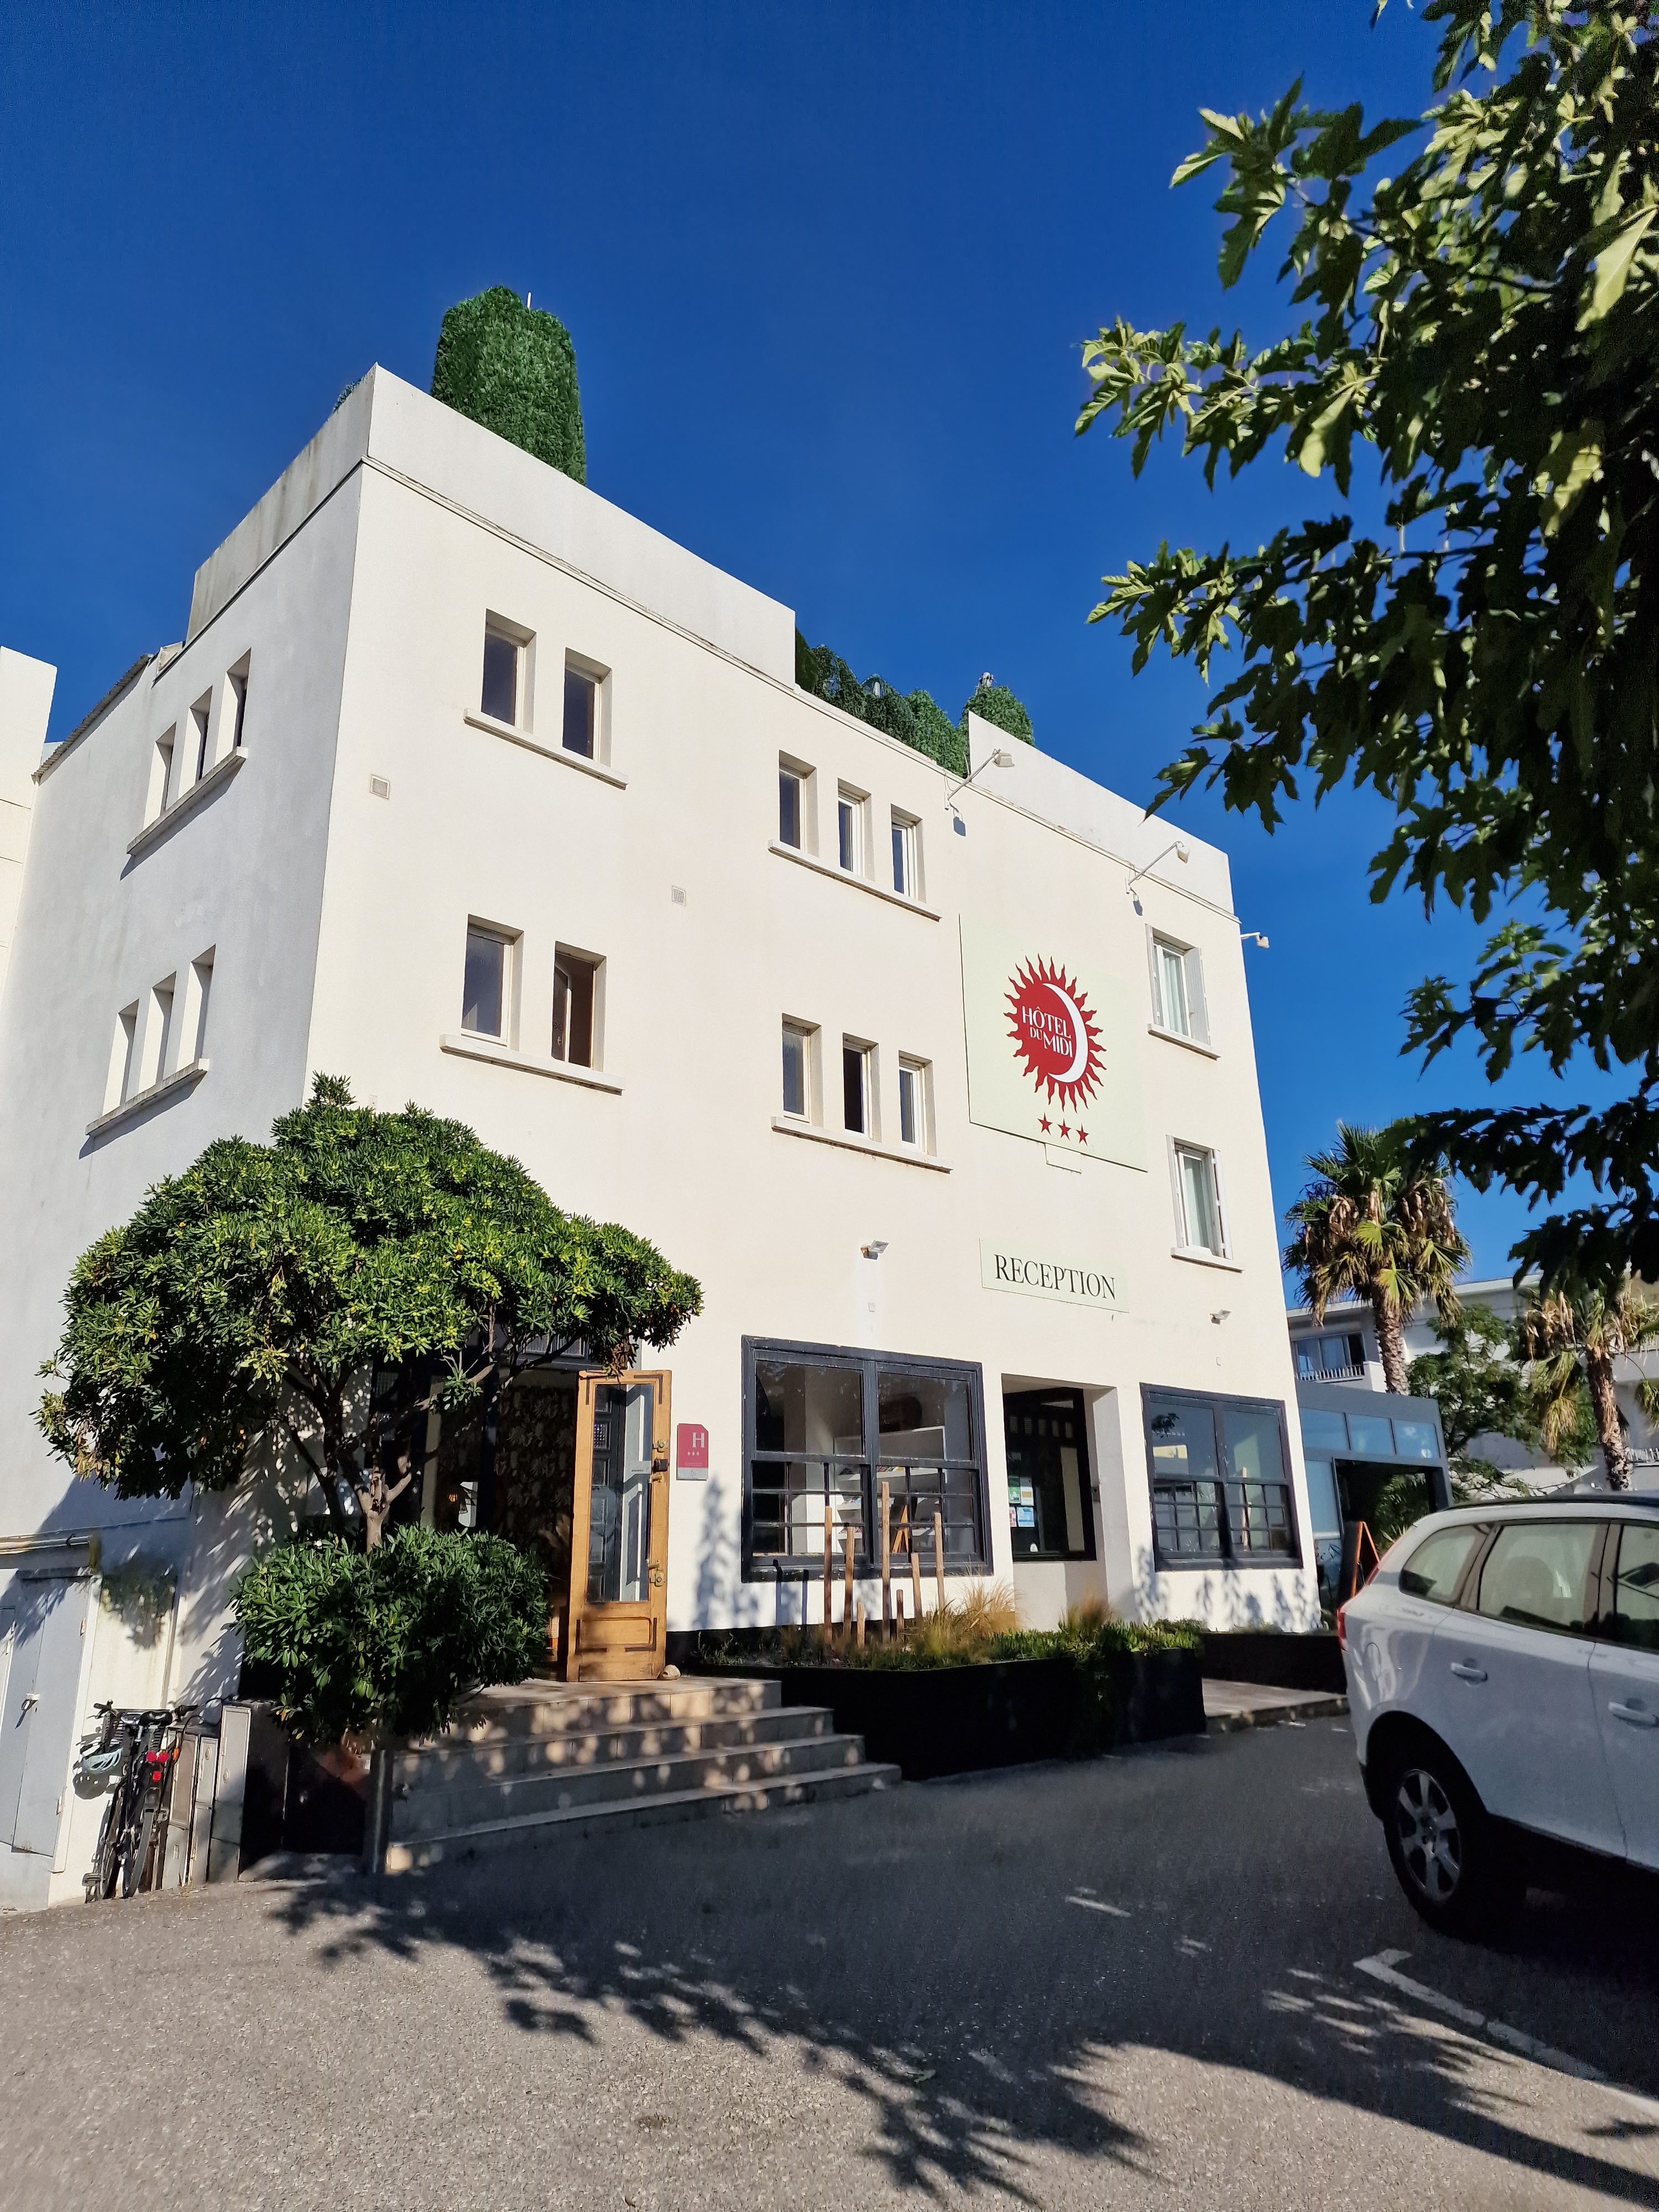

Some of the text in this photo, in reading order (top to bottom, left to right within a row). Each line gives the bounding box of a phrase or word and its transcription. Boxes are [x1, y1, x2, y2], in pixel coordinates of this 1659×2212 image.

[1022, 1005, 1072, 1039] HÔTEL
[1030, 1026, 1073, 1058] DU MIDI
[994, 1254, 1115, 1300] RECEPTION
[692, 1432, 705, 1448] H
